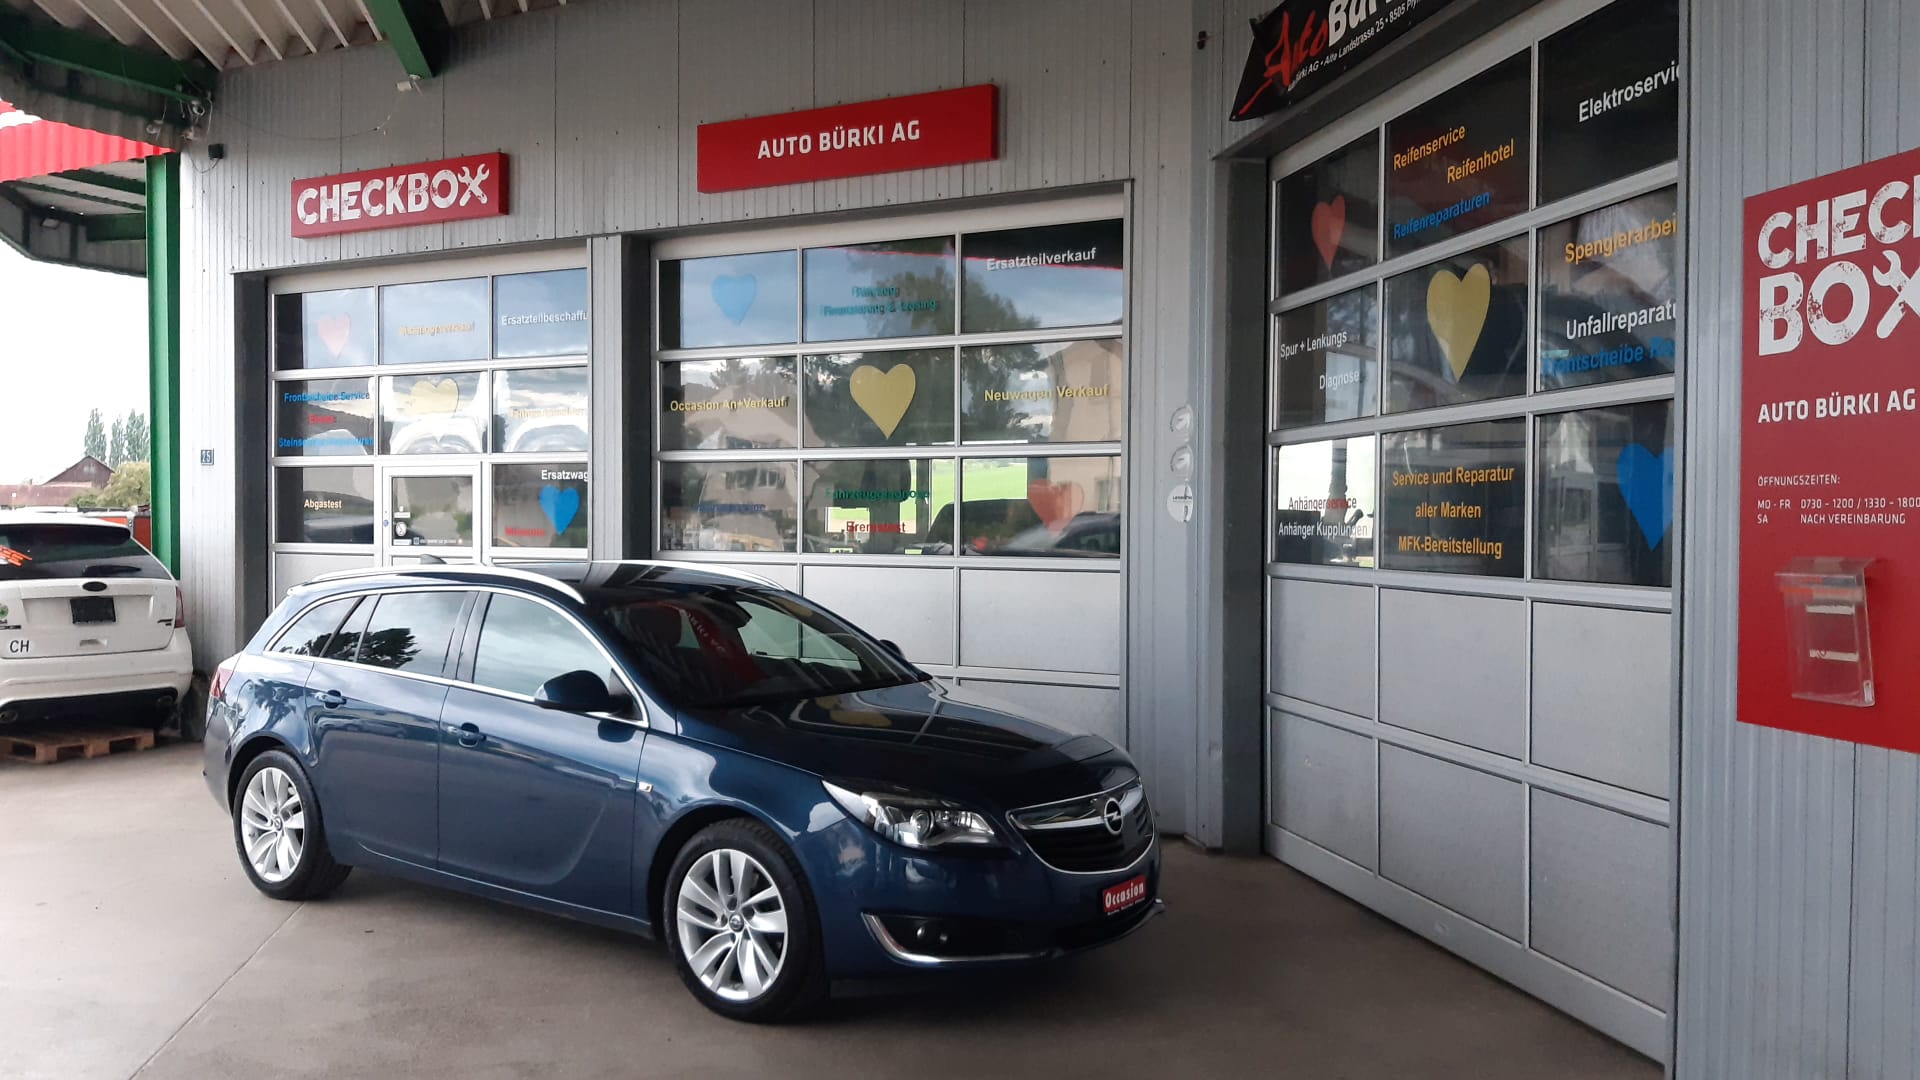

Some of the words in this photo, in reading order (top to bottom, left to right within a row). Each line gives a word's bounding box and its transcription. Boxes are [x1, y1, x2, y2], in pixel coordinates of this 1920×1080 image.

[1376, 18, 1385, 33] 25
[1389, 3, 1406, 24] 8505
[757, 133, 812, 159] AUTO
[819, 124, 885, 152] BÜRKI
[891, 119, 921, 142] AG
[1393, 124, 1465, 170] Reifenservice
[1447, 138, 1514, 184] Reifenhotel
[296, 163, 490, 225] CHECKBOX
[1393, 191, 1490, 239] Reifenreparaturen
[986, 247, 1097, 270] Ersatzteilverkauf
[1280, 342, 1298, 360] Spur
[1307, 331, 1347, 352] Lenkungs
[1319, 370, 1360, 390] Diagnose
[984, 389, 1052, 401] Neuwagen
[1056, 384, 1109, 398] Verkauf
[670, 399, 719, 411] Occasion
[1758, 400, 1809, 424] AUTO
[1815, 392, 1879, 418] BÜRKI
[1886, 388, 1916, 411] AG
[1392, 469, 1428, 486] Service
[1432, 470, 1453, 485] und
[1456, 466, 1514, 486] Reparatur
[304, 499, 342, 510] Abgastest
[1415, 503, 1437, 518] aller
[1440, 502, 1481, 518] Marken
[1757, 499, 1771, 509] MO
[1779, 499, 1791, 509] FR
[1800, 498, 1822, 509] 0730
[1832, 498, 1854, 509] 1200
[1864, 497, 1886, 508] 1330
[1757, 513, 1768, 524] SA
[1800, 513, 1825, 524] NACH
[1829, 513, 1905, 524] VEREINBARUNG
[1279, 521, 1315, 540] Anhänger
[1398, 535, 1503, 559] MFK-Bereitstellung
[10, 640, 29, 653] CH
[1105, 881, 1144, 908] Occasion
